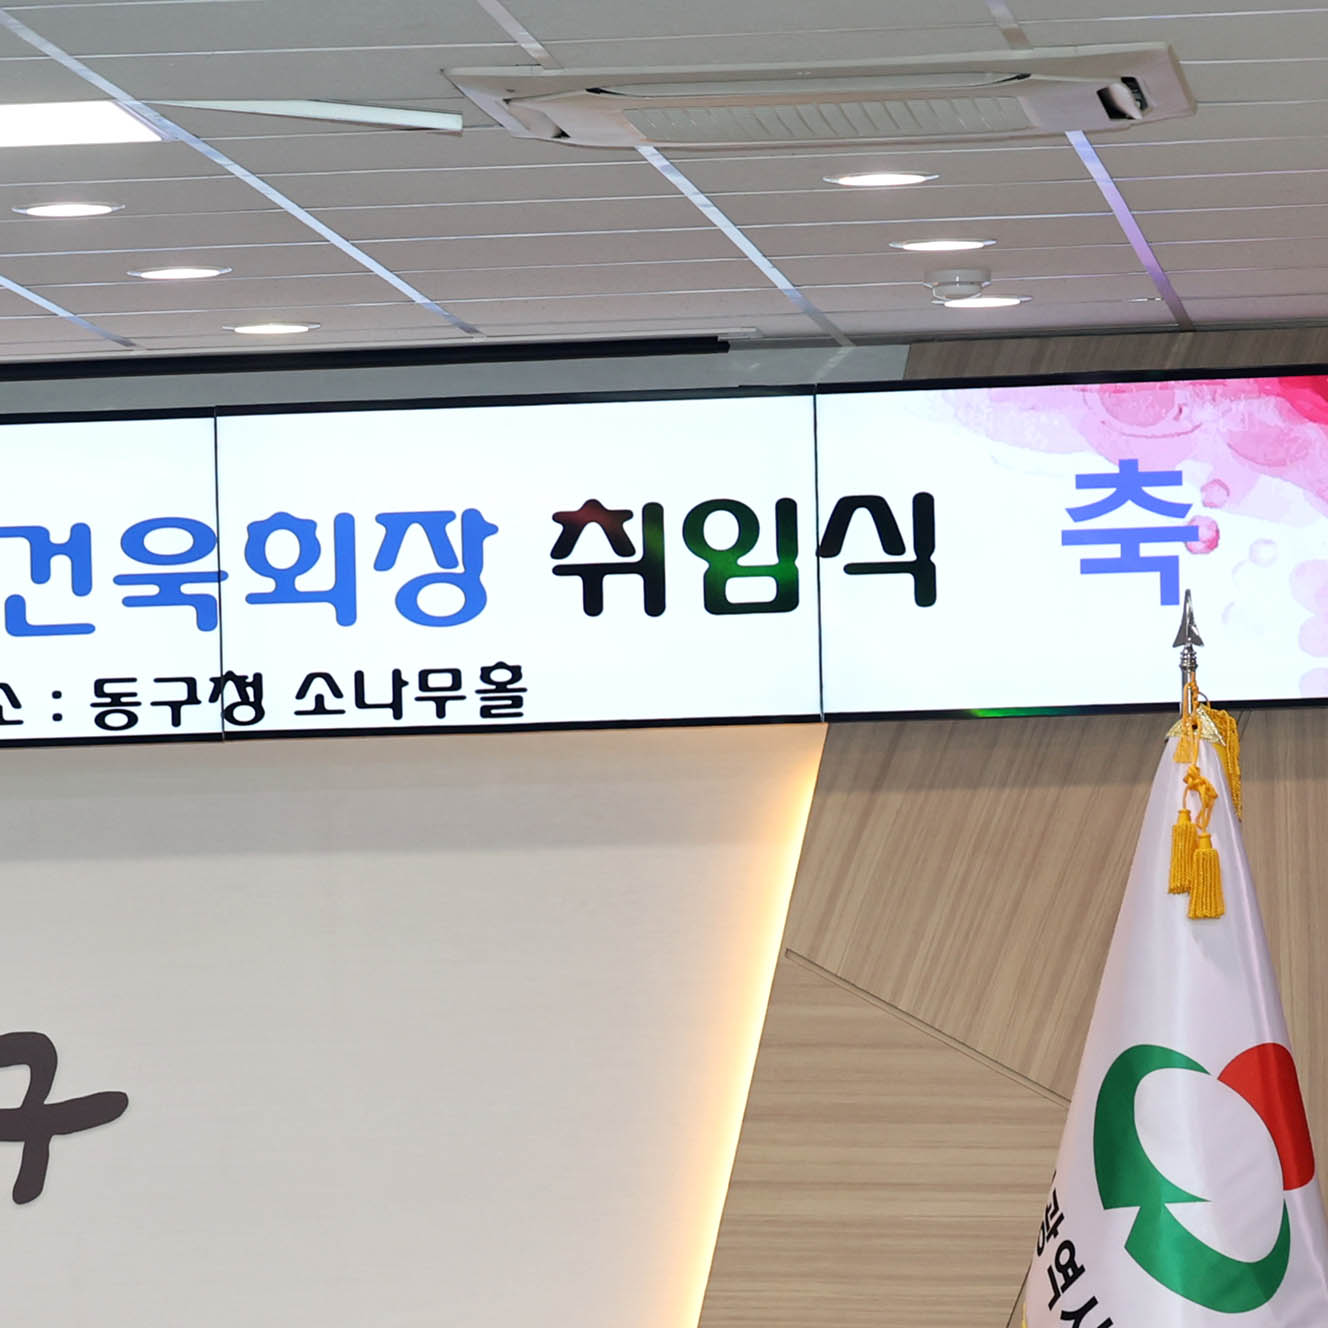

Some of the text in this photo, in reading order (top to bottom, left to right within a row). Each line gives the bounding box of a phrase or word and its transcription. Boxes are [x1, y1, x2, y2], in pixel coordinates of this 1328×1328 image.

[550, 492, 937, 617] 취임식
[1061, 458, 1200, 606] 축
[90, 672, 264, 731] 동구청
[294, 661, 528, 721] 소나무홀
